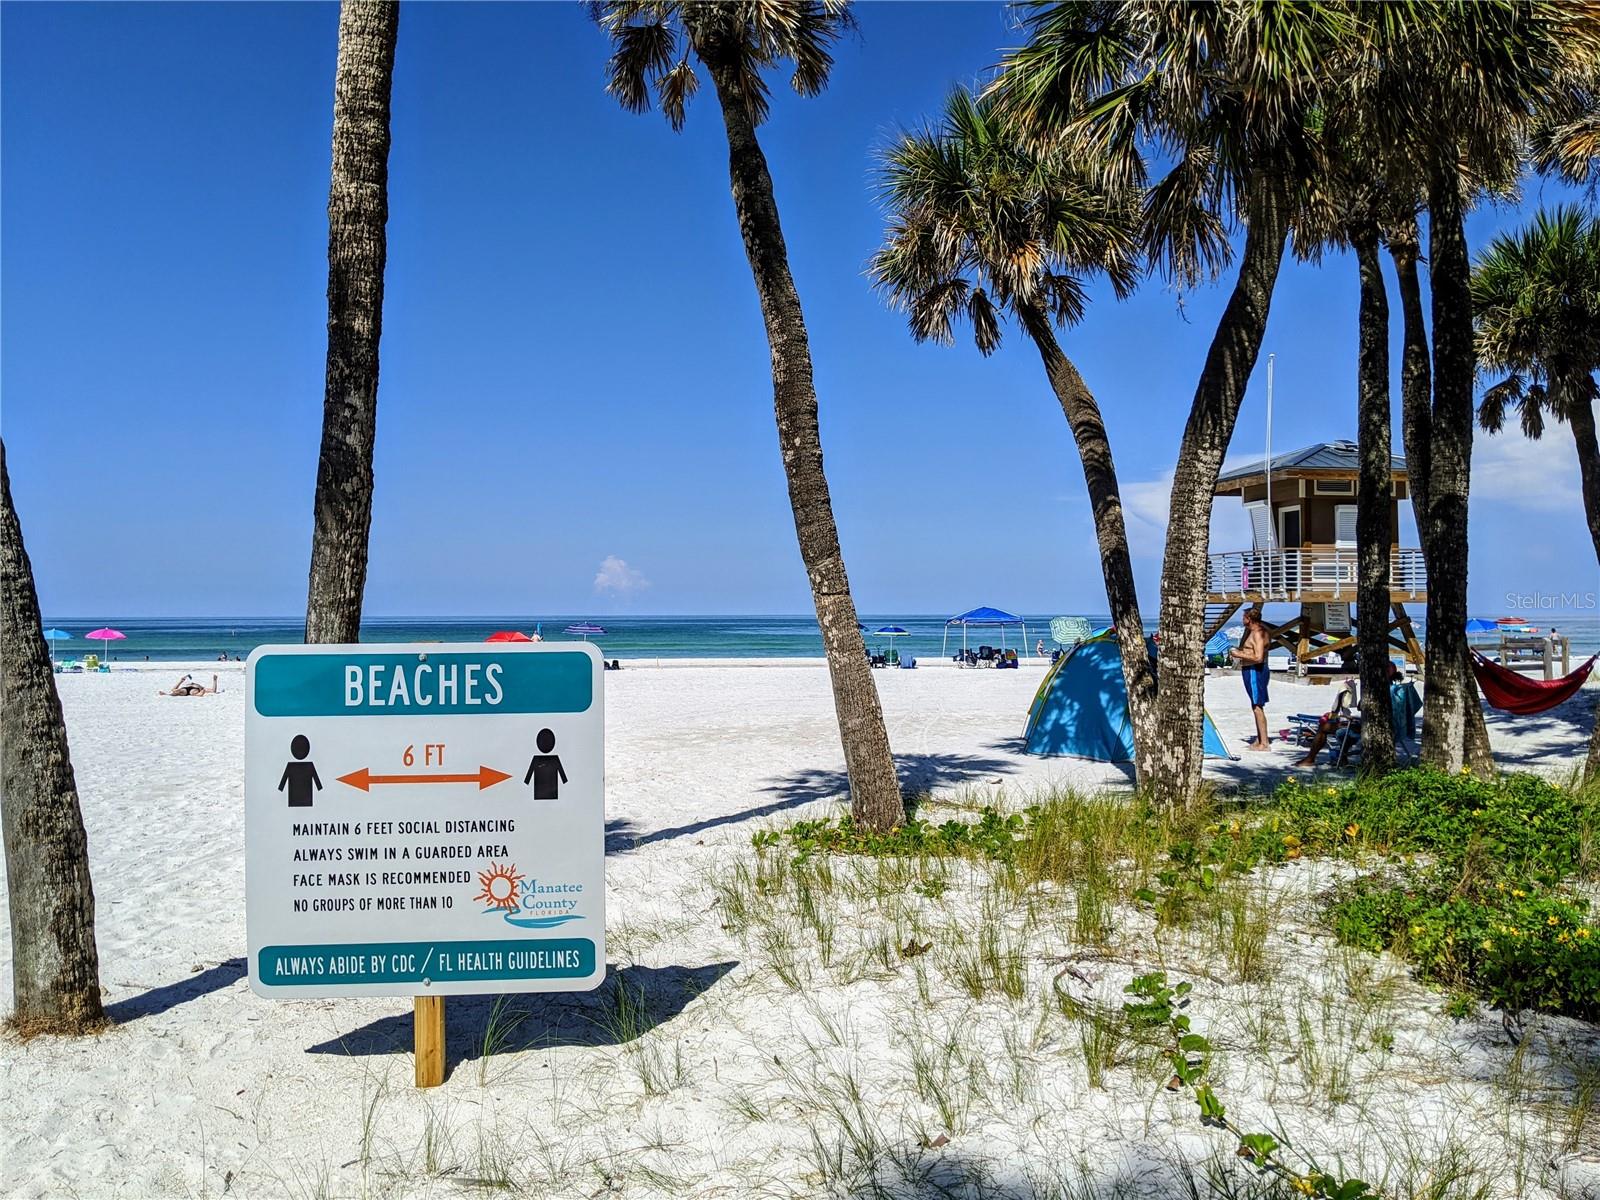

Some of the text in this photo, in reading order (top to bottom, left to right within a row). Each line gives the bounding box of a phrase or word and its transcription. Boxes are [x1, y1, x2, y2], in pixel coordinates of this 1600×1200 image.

[344, 663, 504, 707] BEACHES
[402, 744, 446, 767] 6 FT
[292, 819, 515, 836] MAINTAIN 6 FEET SOCIAL DISTANCING
[293, 845, 509, 862] ALWAYS SWIM IN A GUARDED AREA
[293, 870, 471, 887] FACE MASK IS RECOMMENDED
[519, 879, 583, 894] Manatee
[293, 896, 453, 912] NO GROUPS OF MORE THAN 10
[522, 894, 577, 910] County
[275, 946, 580, 976] ALWAYS ABIDE BY CDC / FL HEALTH GUIDELINES
